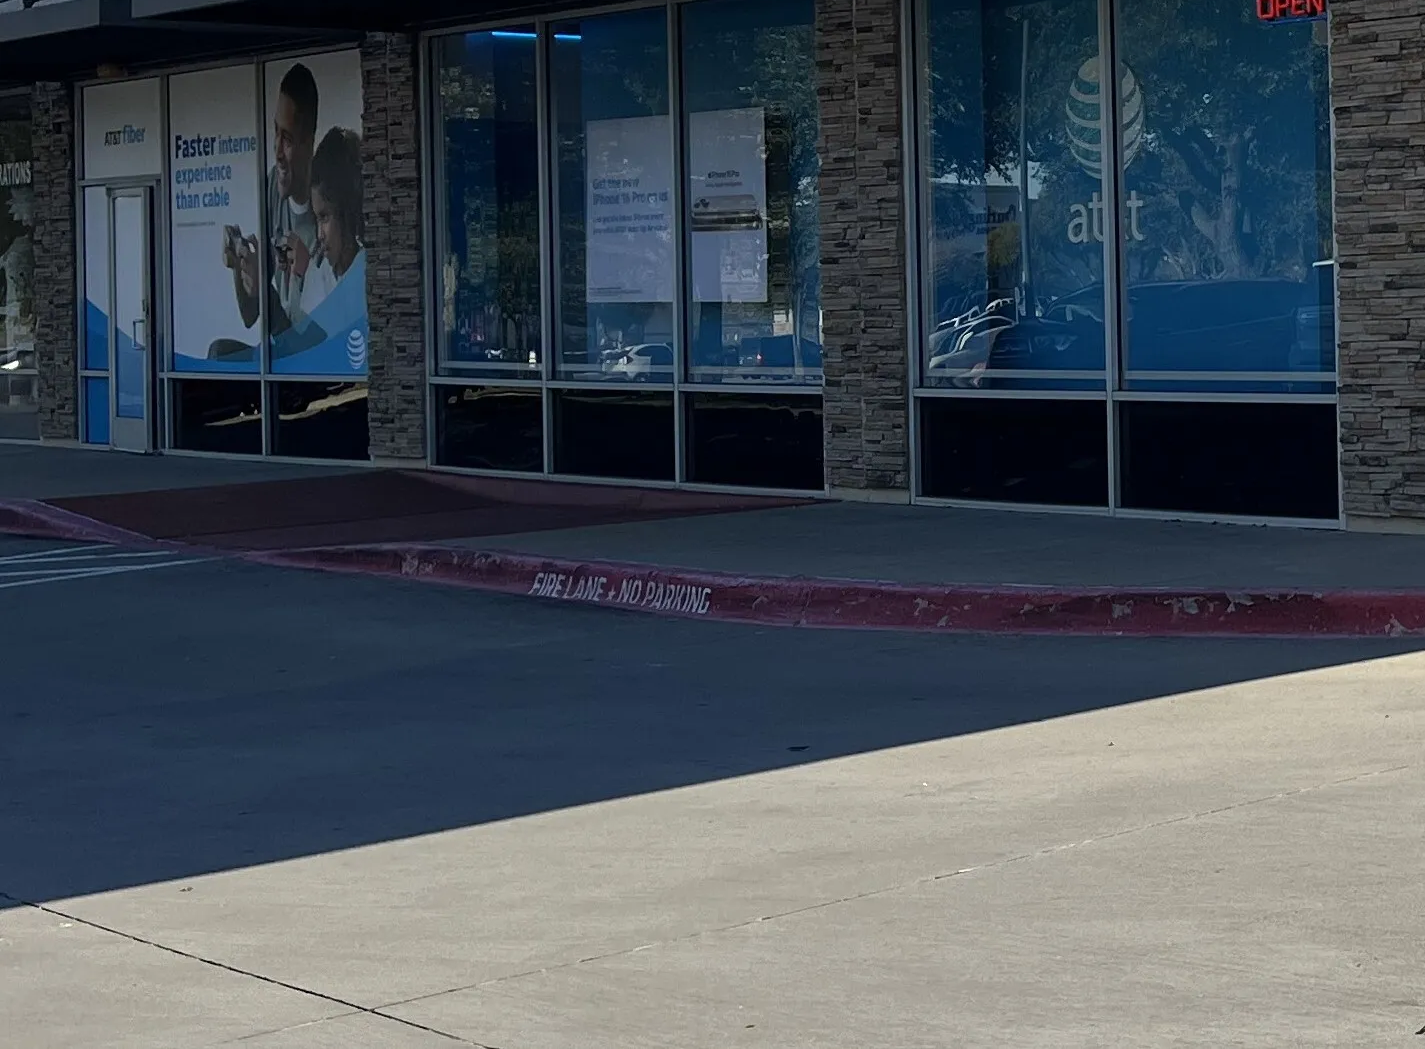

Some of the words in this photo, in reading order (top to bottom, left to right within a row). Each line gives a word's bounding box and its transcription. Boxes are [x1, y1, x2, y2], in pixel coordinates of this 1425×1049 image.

[175, 133, 216, 159] Faster
[218, 134, 257, 155] interne
[175, 160, 232, 190] experience
[176, 189, 200, 210] than
[202, 186, 230, 207] cable
[1067, 190, 1144, 244] att
[528, 572, 566, 598] FIRE
[562, 575, 608, 602] LANE
[617, 578, 642, 604] NO
[641, 581, 712, 615] PARKING
